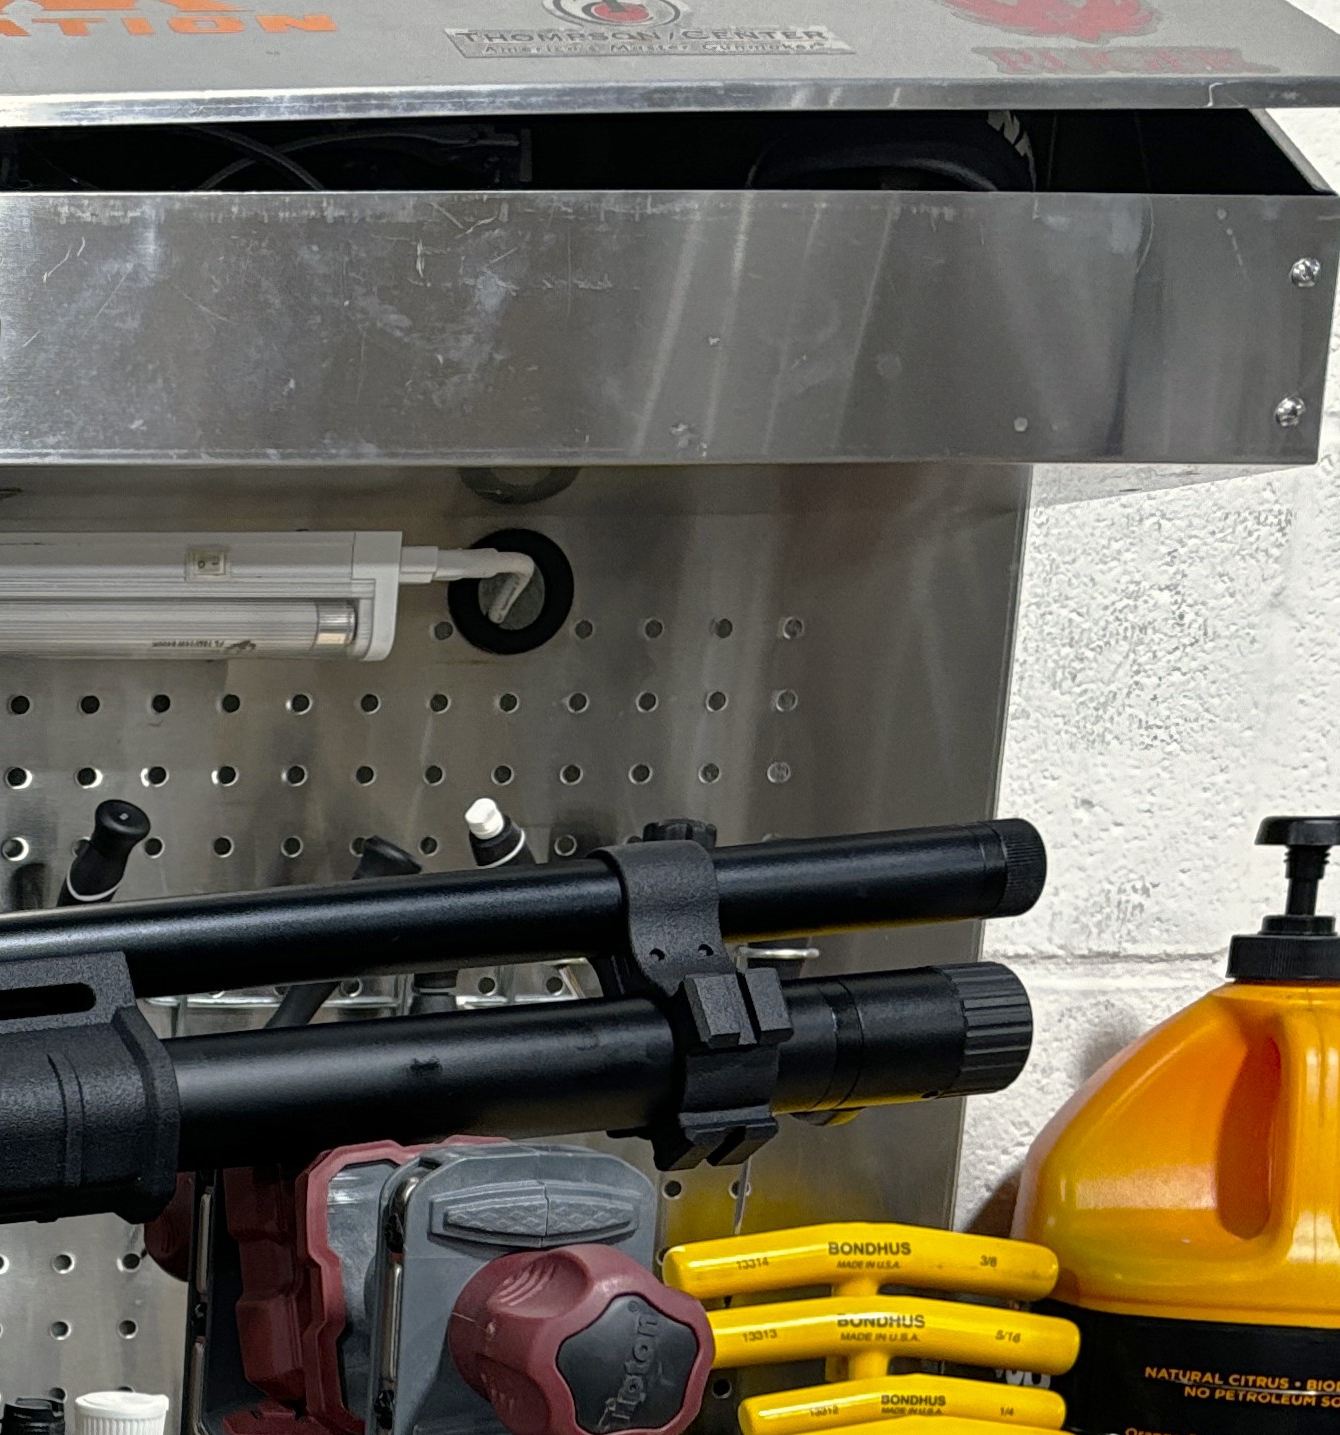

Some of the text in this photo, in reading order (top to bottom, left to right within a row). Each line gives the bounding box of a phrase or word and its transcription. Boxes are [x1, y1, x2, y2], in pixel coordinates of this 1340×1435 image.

[827, 1241, 912, 1257] BONDHUS
[836, 1259, 864, 1271] MADE
[865, 1260, 875, 1270] IN
[980, 1254, 998, 1269] 3/8
[836, 1312, 926, 1330] BONDHUS
[840, 1331, 872, 1344] MADE
[873, 1331, 887, 1344] IN
[1144, 1365, 1224, 1386] NATURAL
[1228, 1373, 1290, 1389] CITRUS
[880, 1393, 947, 1407] BONDHUS
[1183, 1386, 1210, 1399] NO
[1214, 1388, 1316, 1407] PETROLEUM
[881, 1406, 907, 1417] MADE
